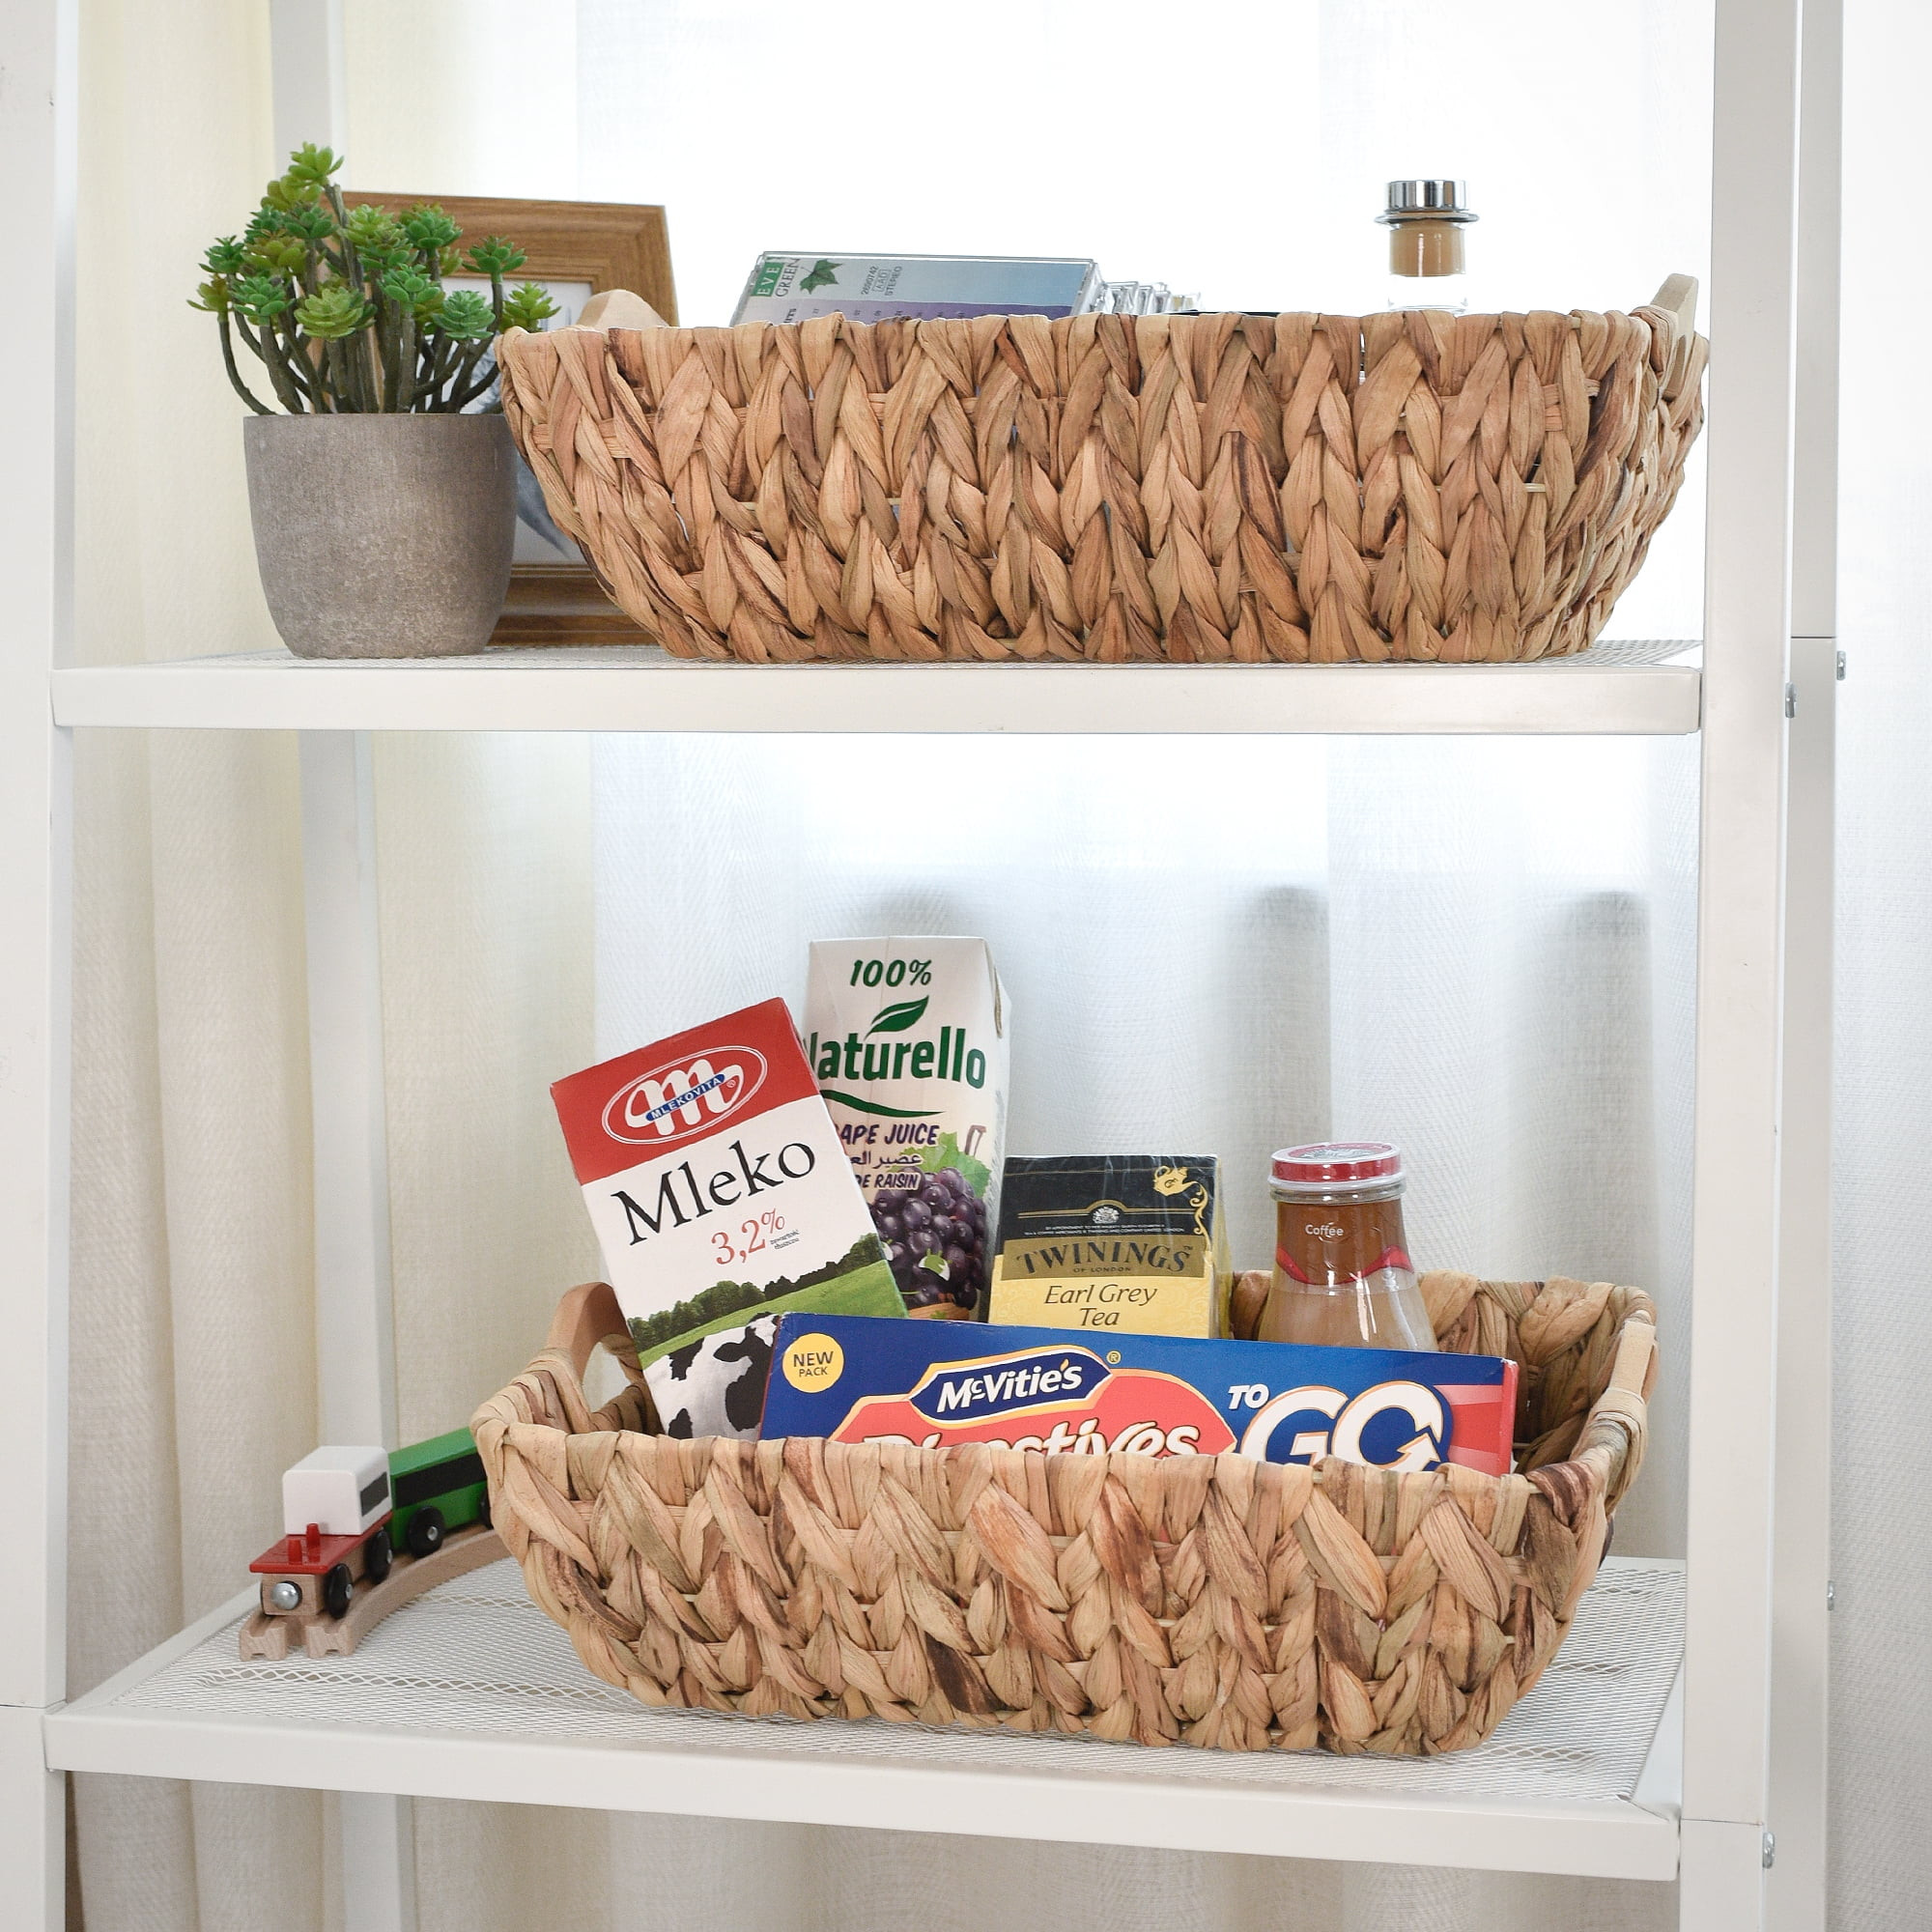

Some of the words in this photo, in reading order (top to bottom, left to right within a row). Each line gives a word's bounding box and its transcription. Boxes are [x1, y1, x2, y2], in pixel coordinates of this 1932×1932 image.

[884, 266, 903, 297] STEREO
[850, 959, 932, 987] 100%
[650, 1077, 723, 1121] MLEKOVITA
[834, 1123, 880, 1145] APE
[884, 1123, 940, 1145] JUICE
[871, 1154, 923, 1169] عصير
[611, 1140, 815, 1246] Mleko
[873, 1173, 919, 1188] RAISIN
[711, 1208, 785, 1265] 3,2%
[1305, 1224, 1344, 1236] Coffee
[1016, 1241, 1191, 1274] TWININGS
[1044, 1284, 1094, 1305] Earl
[1099, 1283, 1158, 1307] Grey
[1079, 1307, 1121, 1326] Tea
[793, 1350, 834, 1368] NEW
[798, 1366, 829, 1378] PACK
[936, 1358, 1083, 1413] McVitie's
[1228, 1383, 1269, 1409] TO
